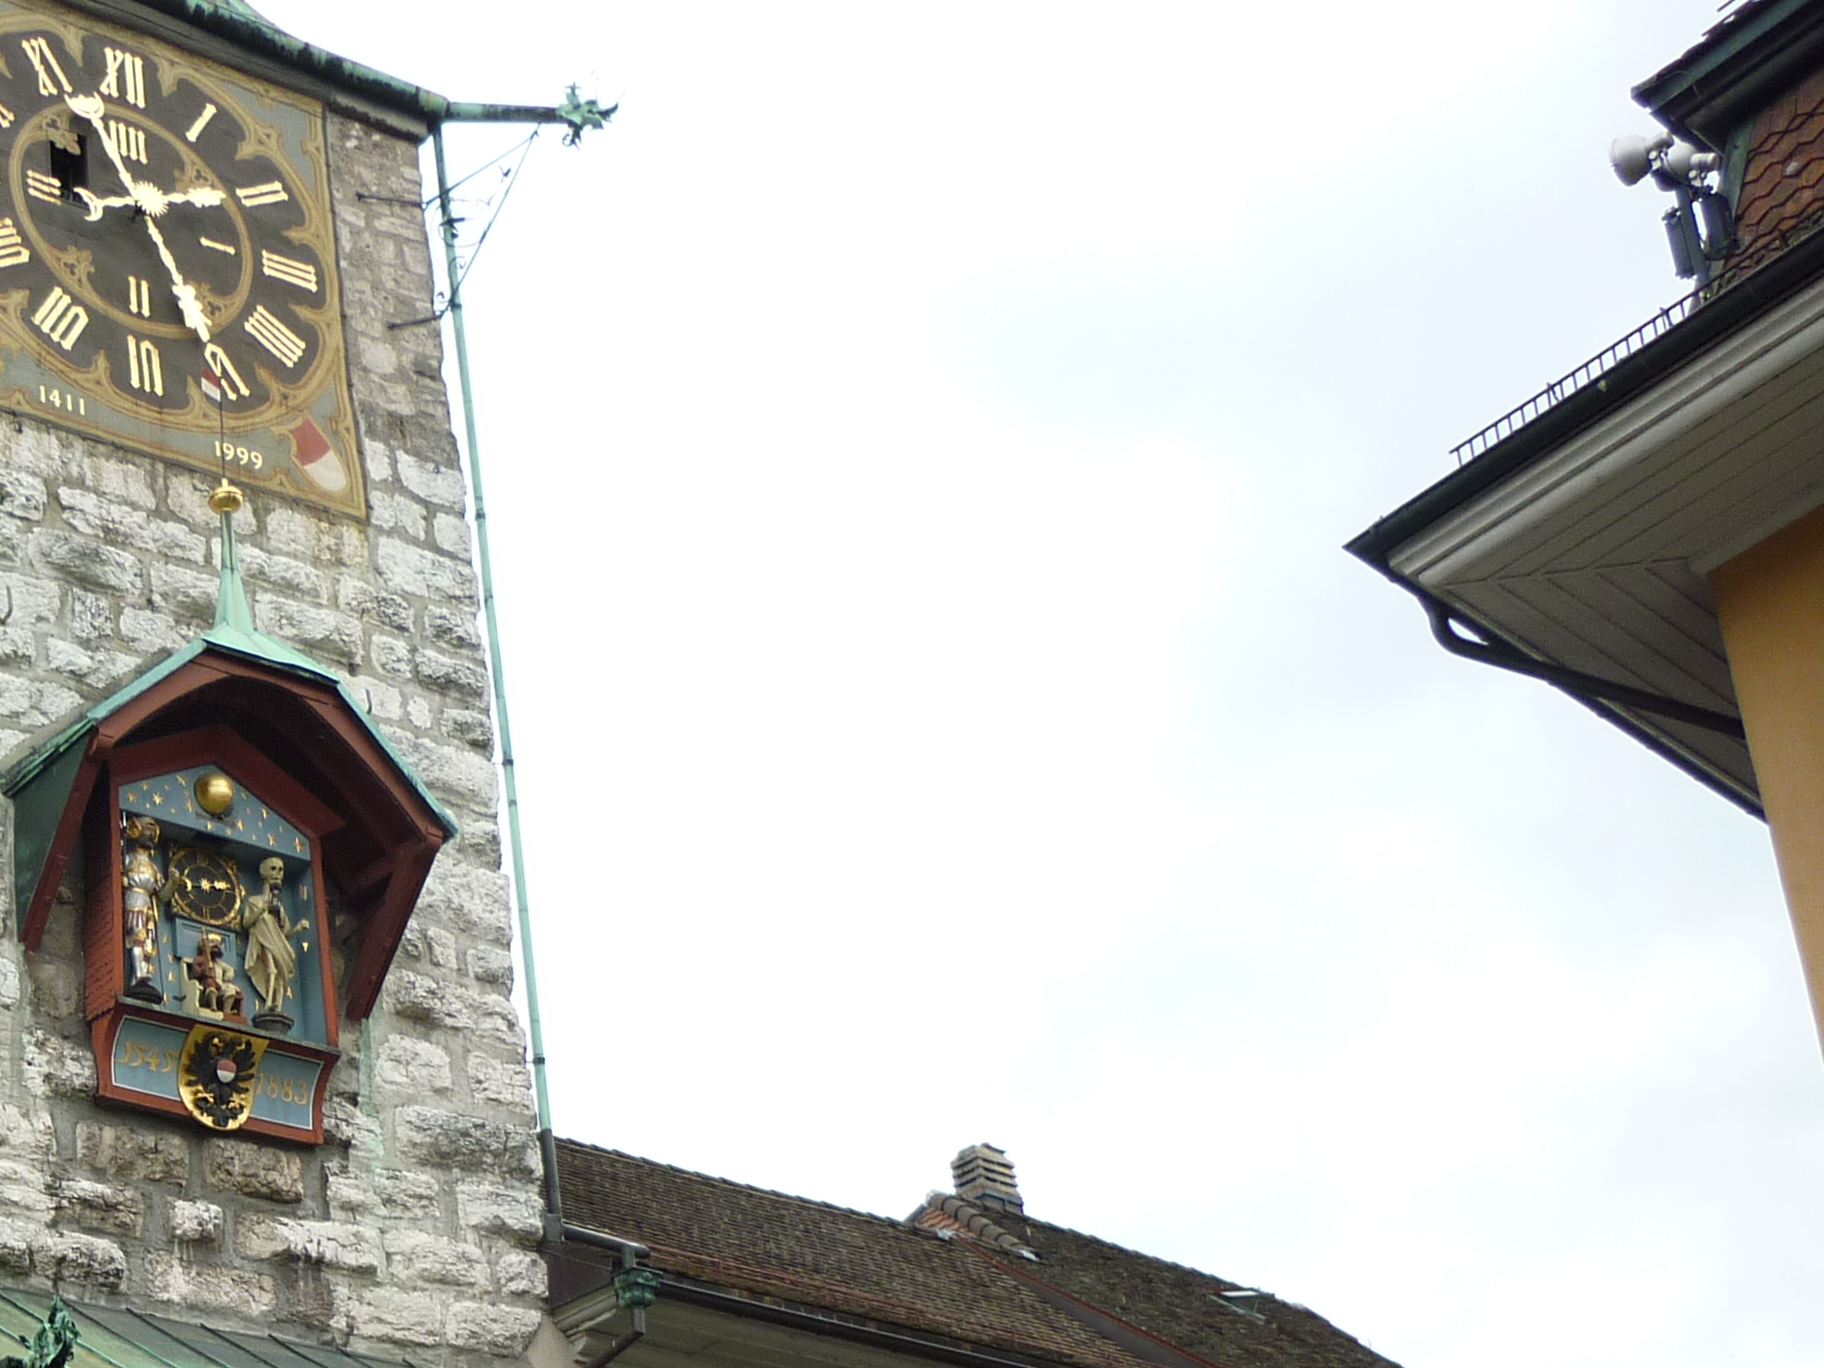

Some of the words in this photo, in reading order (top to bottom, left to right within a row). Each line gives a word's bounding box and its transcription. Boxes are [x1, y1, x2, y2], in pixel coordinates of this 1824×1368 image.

[99, 47, 146, 109] XII
[39, 385, 86, 415] 1411
[214, 440, 263, 470] 1999
[117, 1041, 178, 1072] 1545
[255, 1072, 308, 1106] 1883
